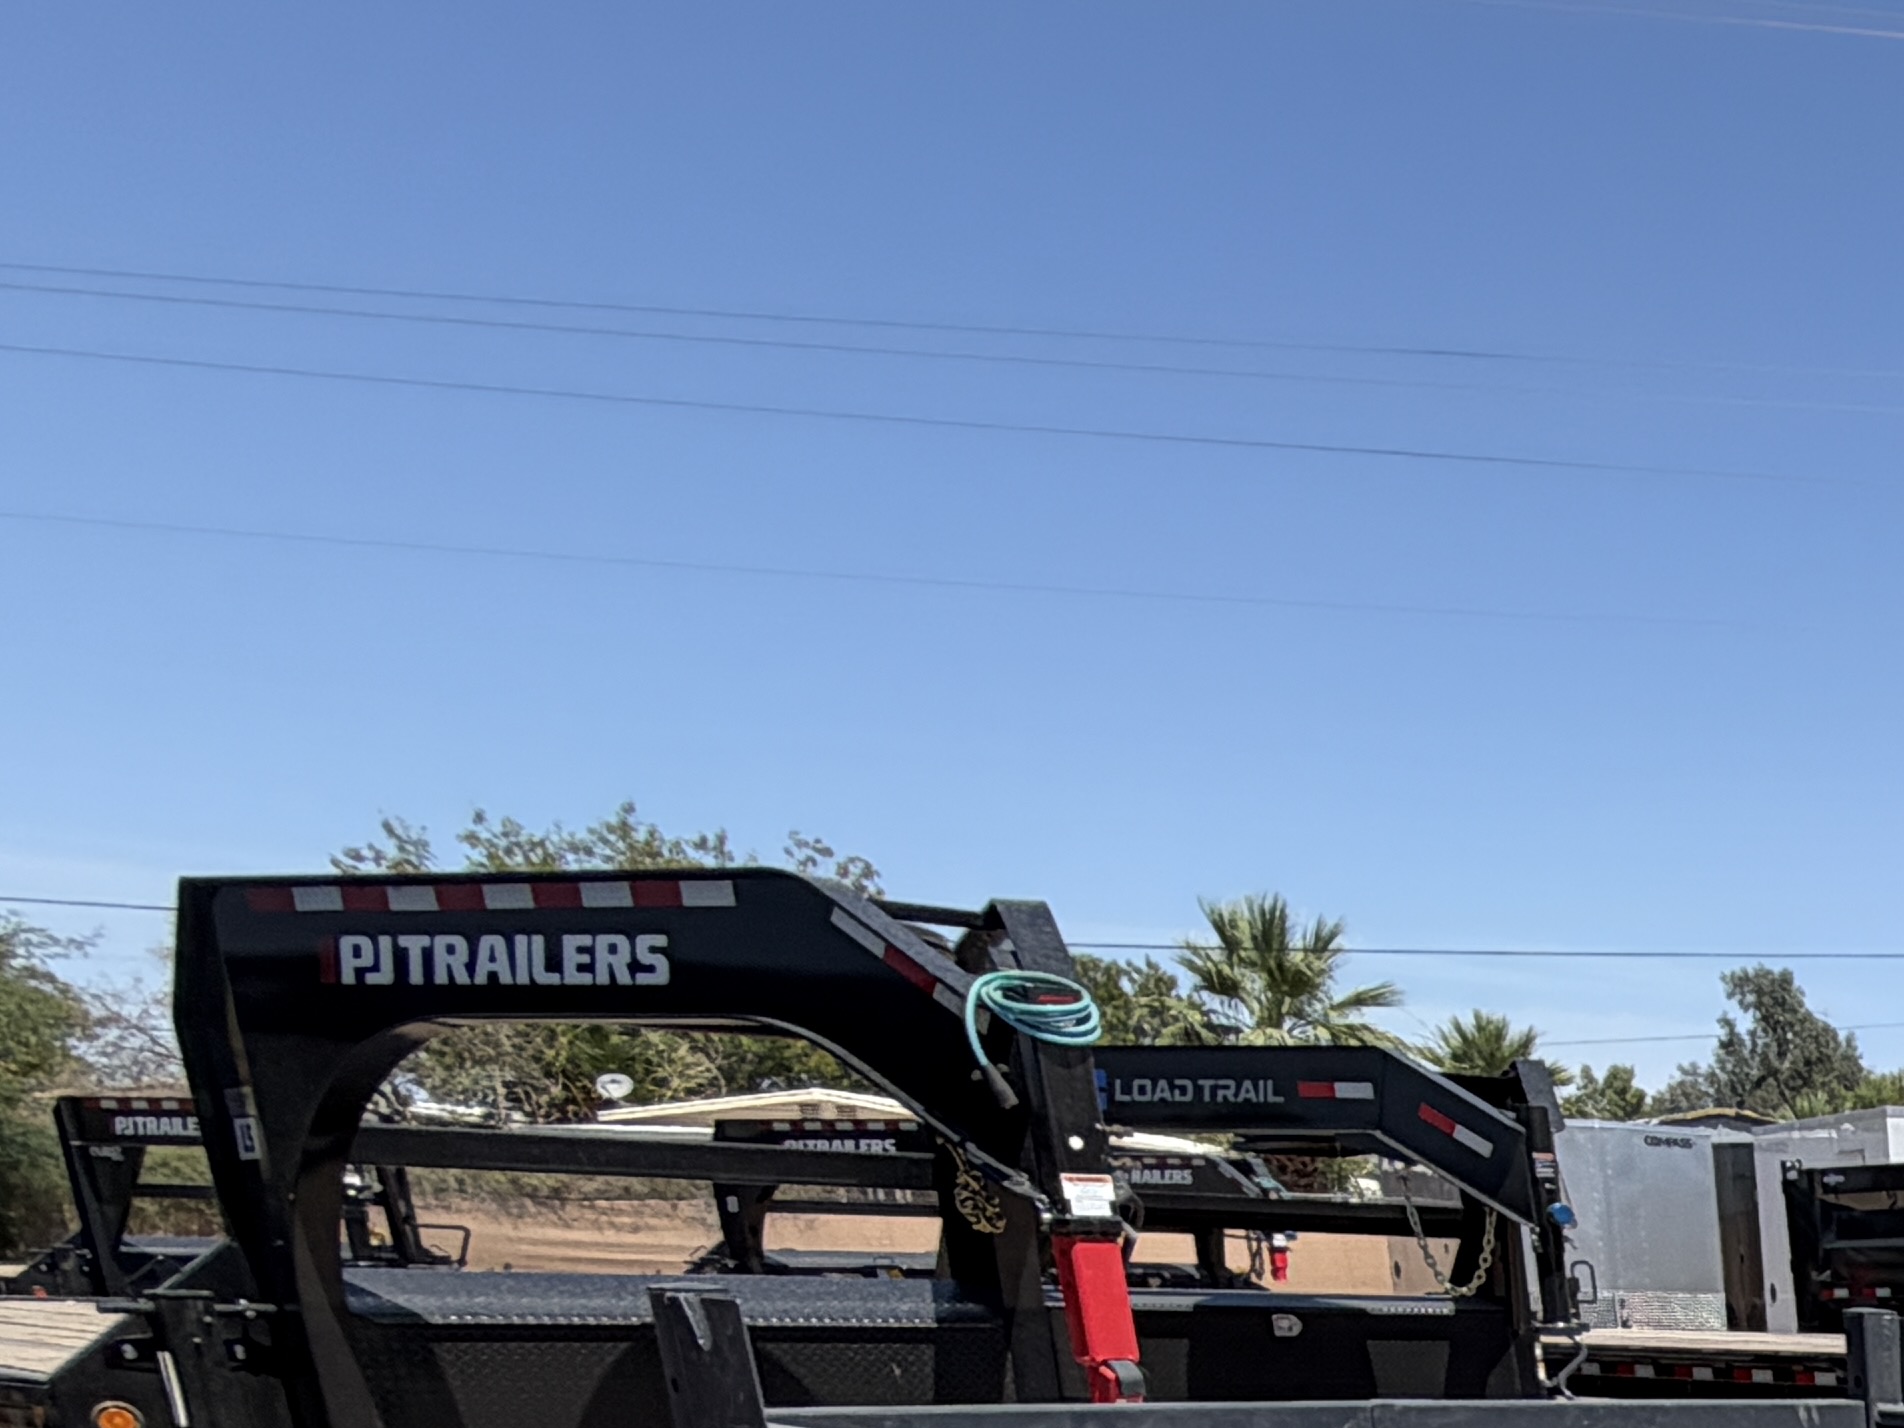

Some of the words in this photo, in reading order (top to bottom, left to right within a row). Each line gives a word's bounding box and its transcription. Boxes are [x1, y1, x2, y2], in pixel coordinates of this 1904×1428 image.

[397, 933, 670, 985] TRAILERS
[1114, 1078, 1194, 1102] LOAD
[1197, 1078, 1285, 1103] TRAIL
